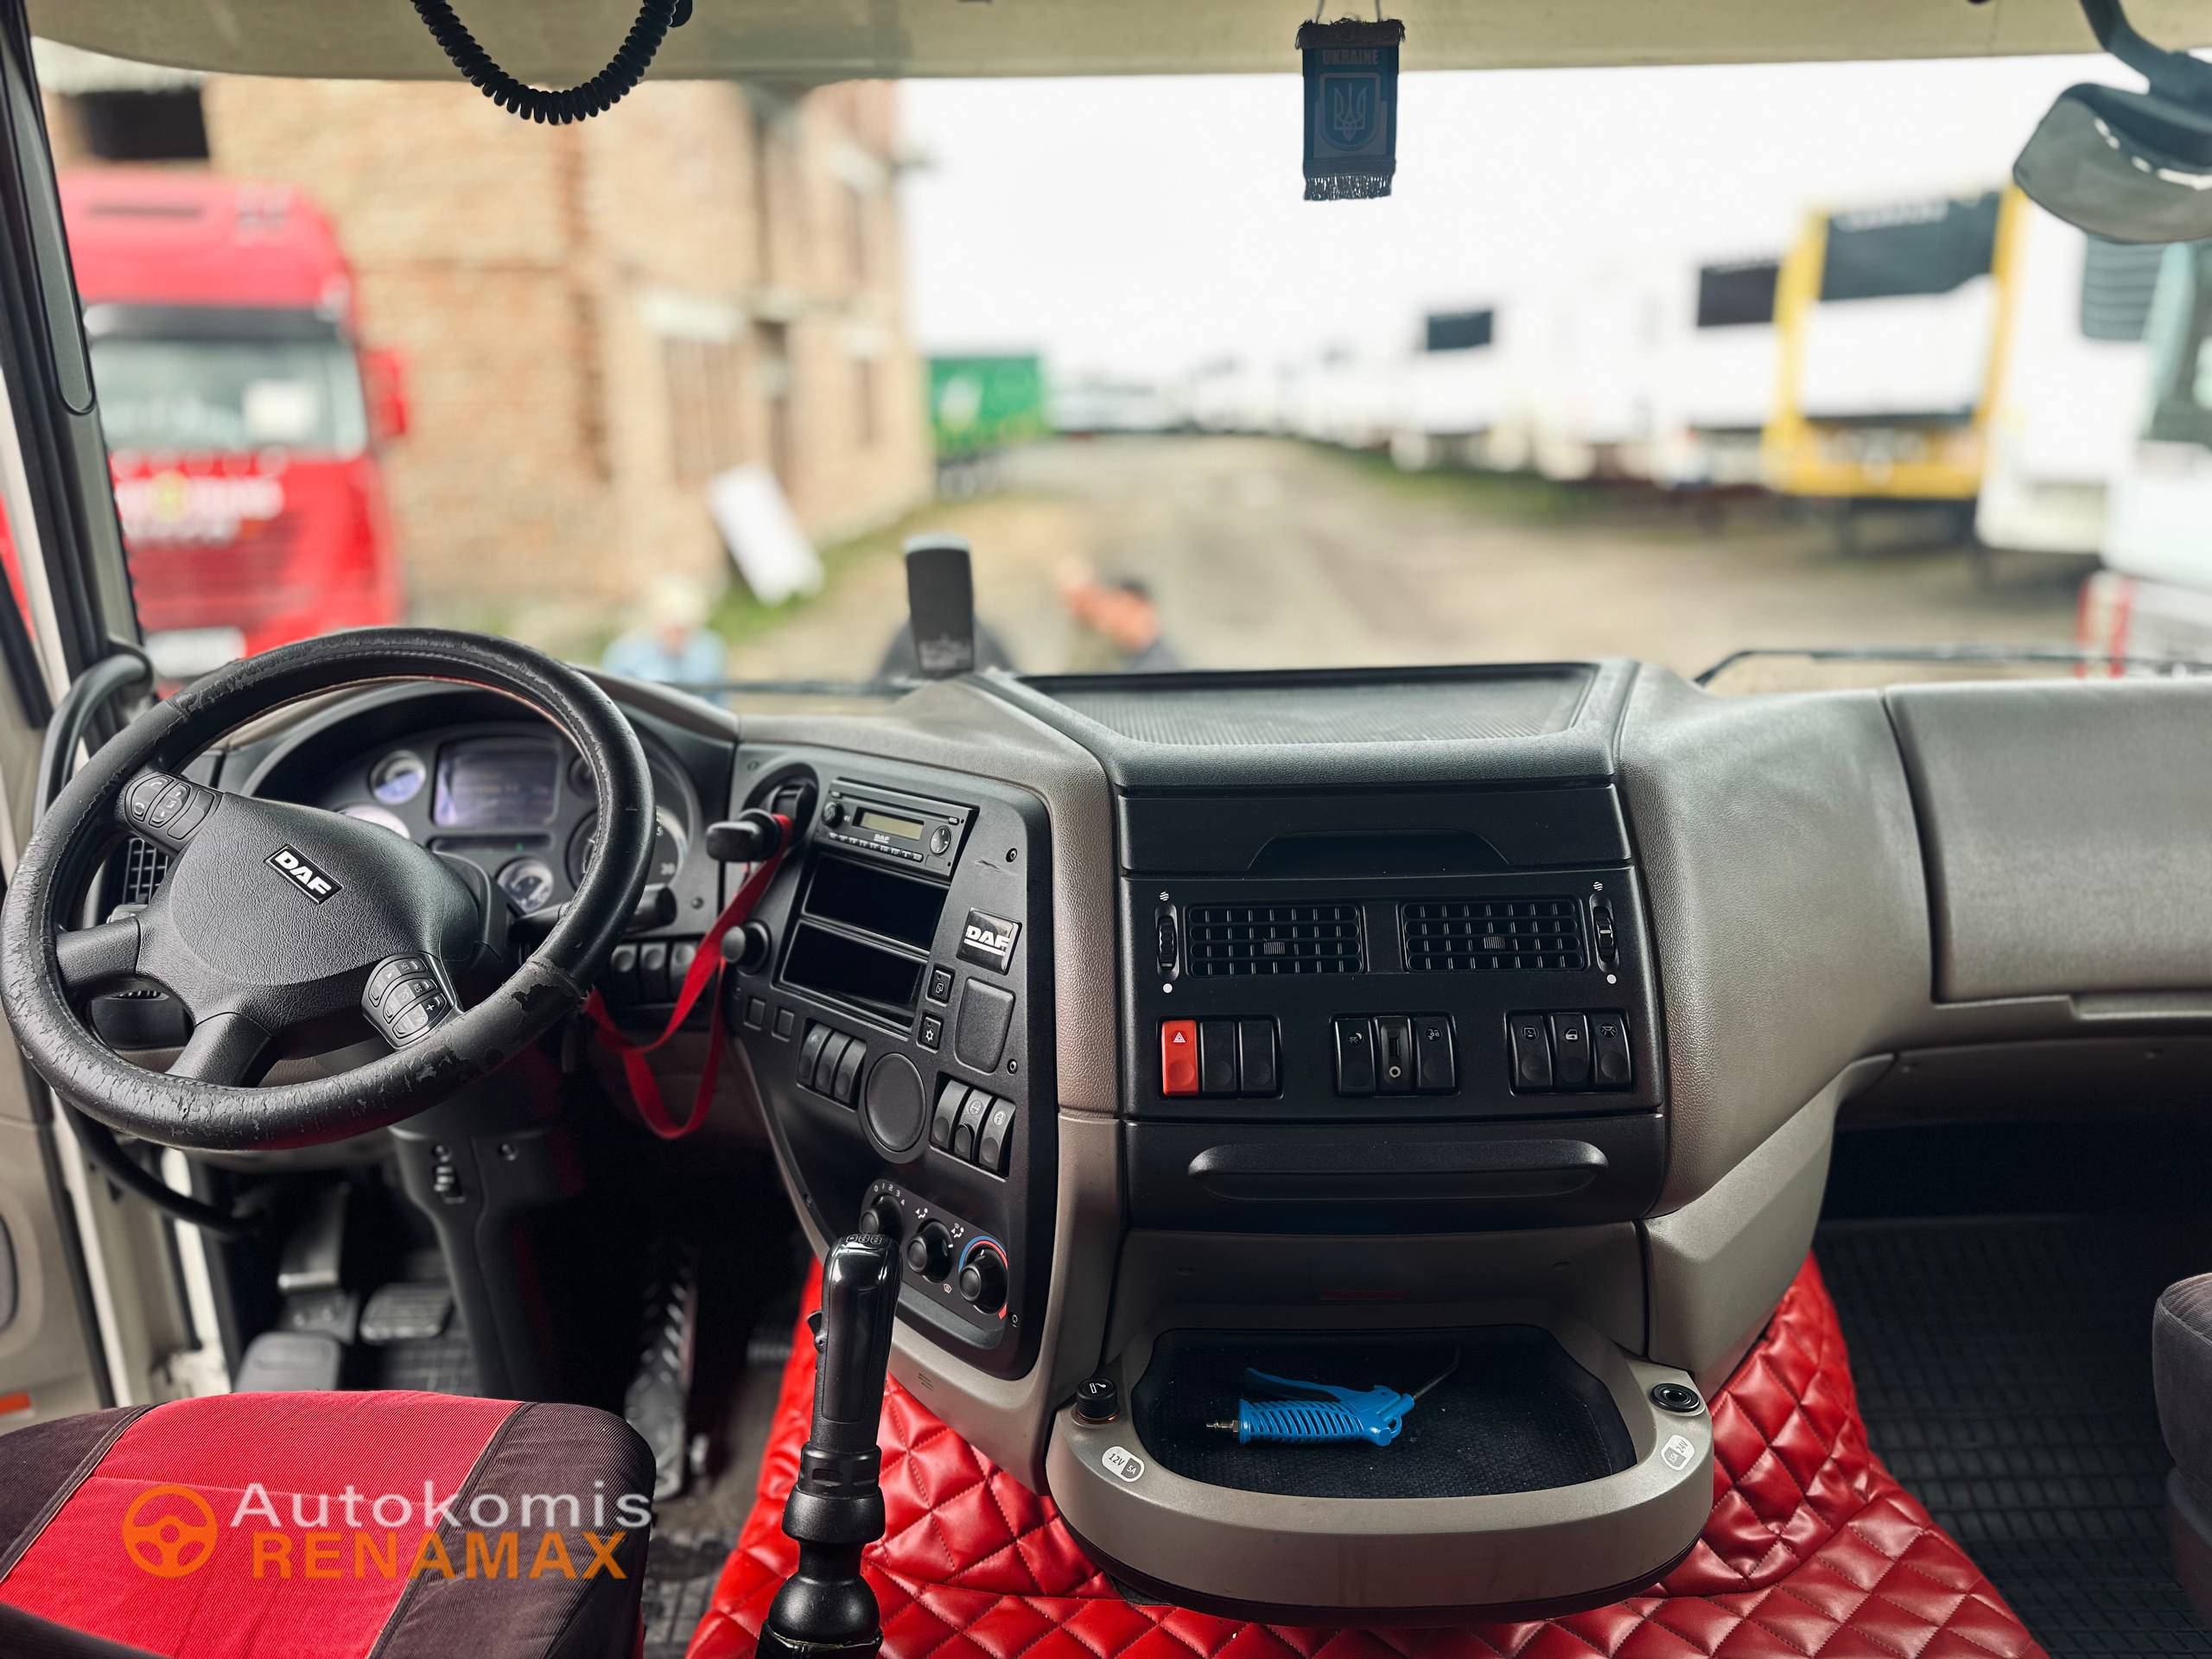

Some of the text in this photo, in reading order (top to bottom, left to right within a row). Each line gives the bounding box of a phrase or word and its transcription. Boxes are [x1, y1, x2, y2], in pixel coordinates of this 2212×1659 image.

[874, 833, 891, 842] DAF
[275, 850, 332, 895] DAF
[965, 925, 1011, 950] DAF
[1109, 1453, 1137, 1475] 12V 5A
